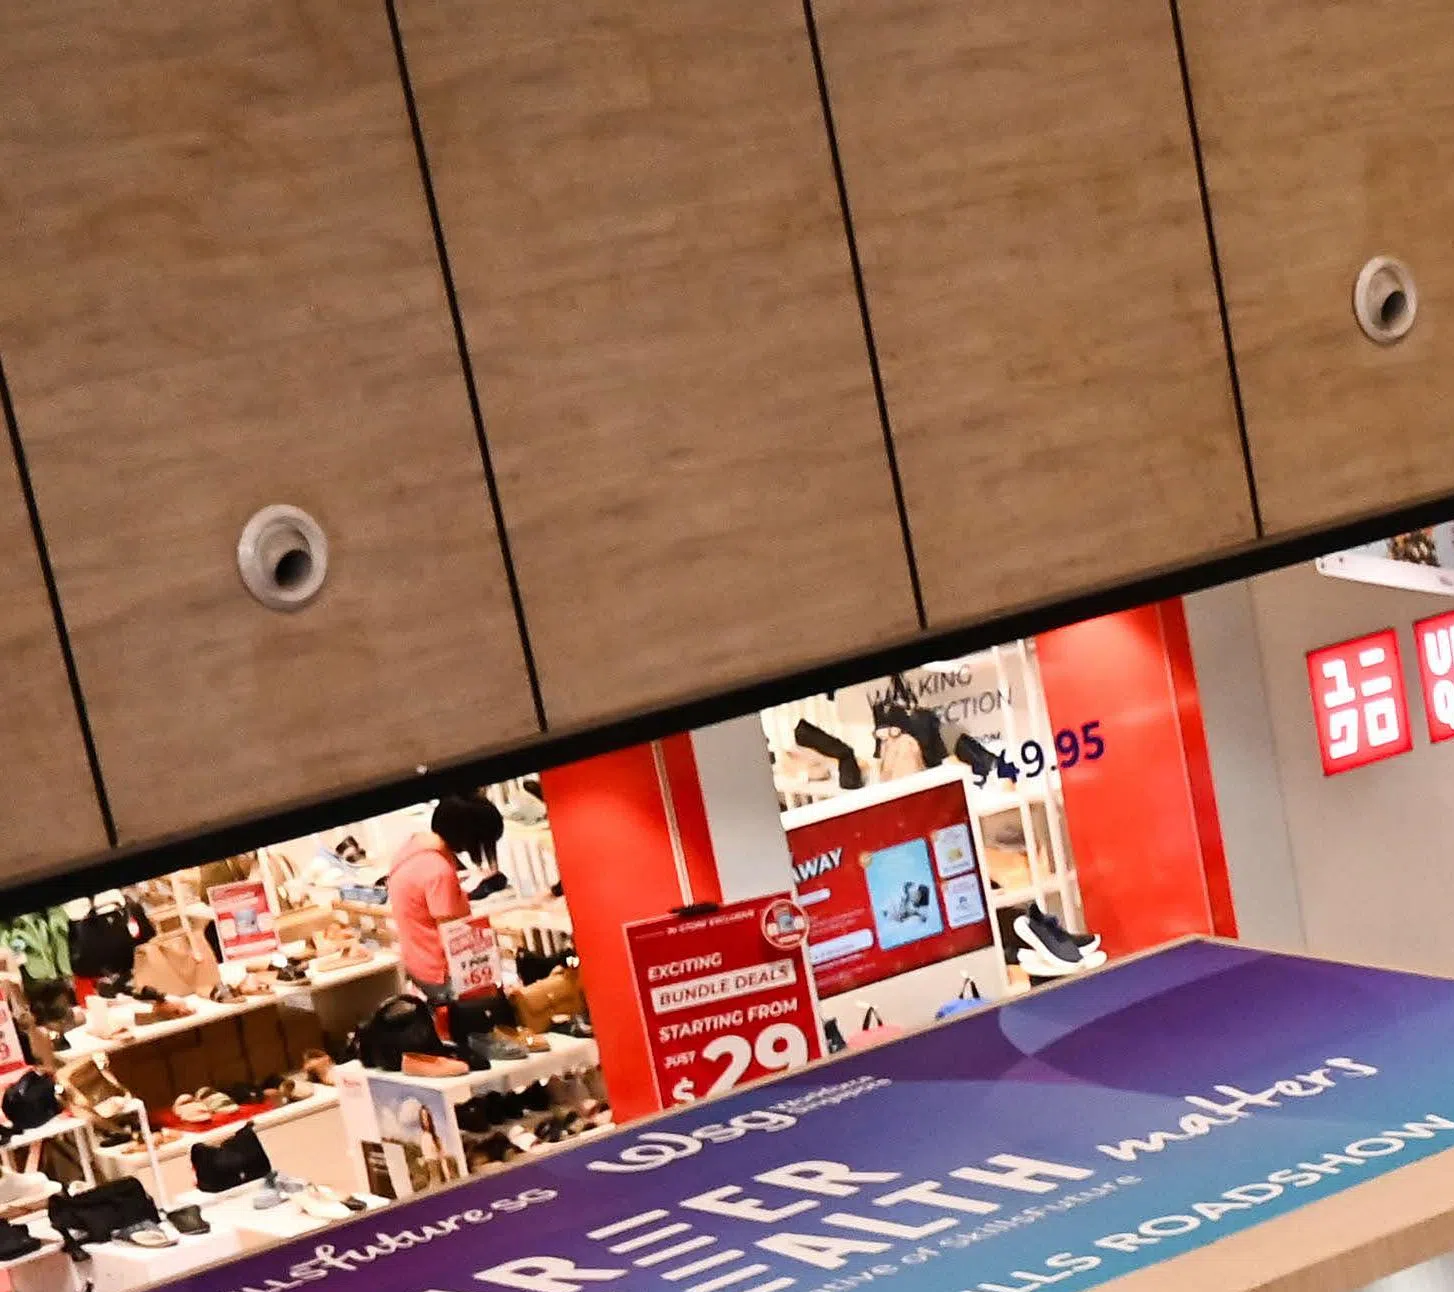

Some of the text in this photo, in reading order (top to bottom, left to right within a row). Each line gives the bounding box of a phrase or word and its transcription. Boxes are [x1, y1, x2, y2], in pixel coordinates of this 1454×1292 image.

[648, 952, 723, 982] EXCITING
[659, 963, 791, 1007] BUNDLE DEALS
[657, 998, 799, 1043] STARTING FROM
[663, 1050, 697, 1070] JUST
[1098, 1056, 1379, 1162] matters
